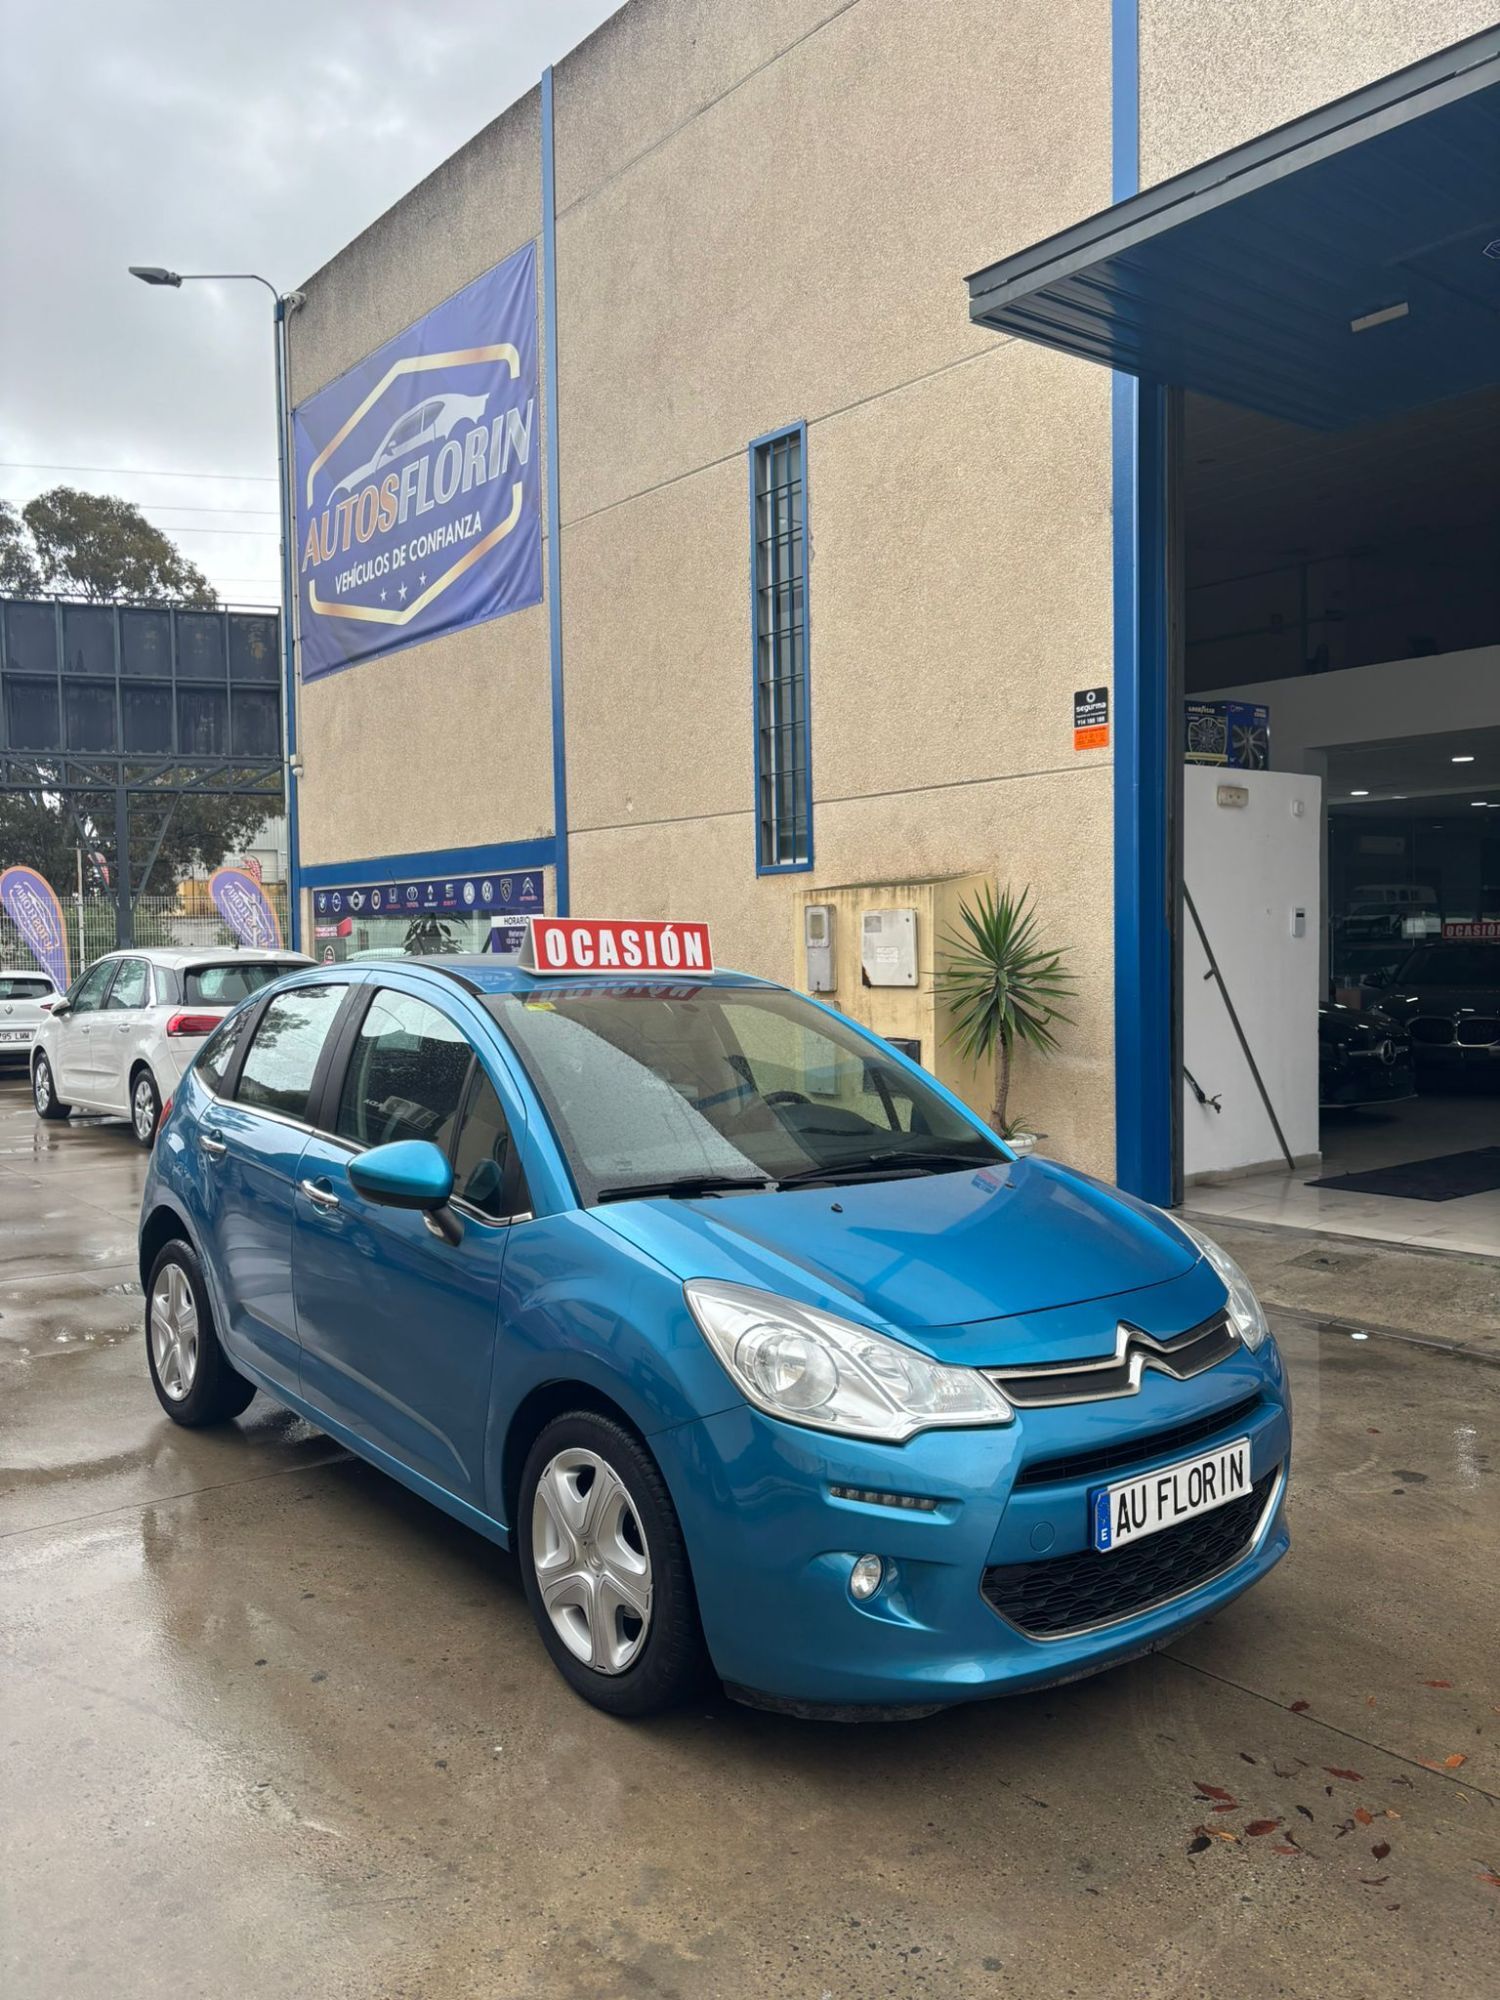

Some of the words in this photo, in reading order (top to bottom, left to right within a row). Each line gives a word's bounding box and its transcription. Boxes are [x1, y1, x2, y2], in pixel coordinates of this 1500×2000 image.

[335, 552, 390, 594] VEHÍCULOS
[392, 544, 406, 570] DE
[409, 511, 482, 561] CONFIANZA
[545, 925, 704, 967] OCASIÓN
[1116, 1484, 1147, 1538] AU
[1157, 1450, 1244, 1521] FLORIN
[1101, 1528, 1108, 1541] E
